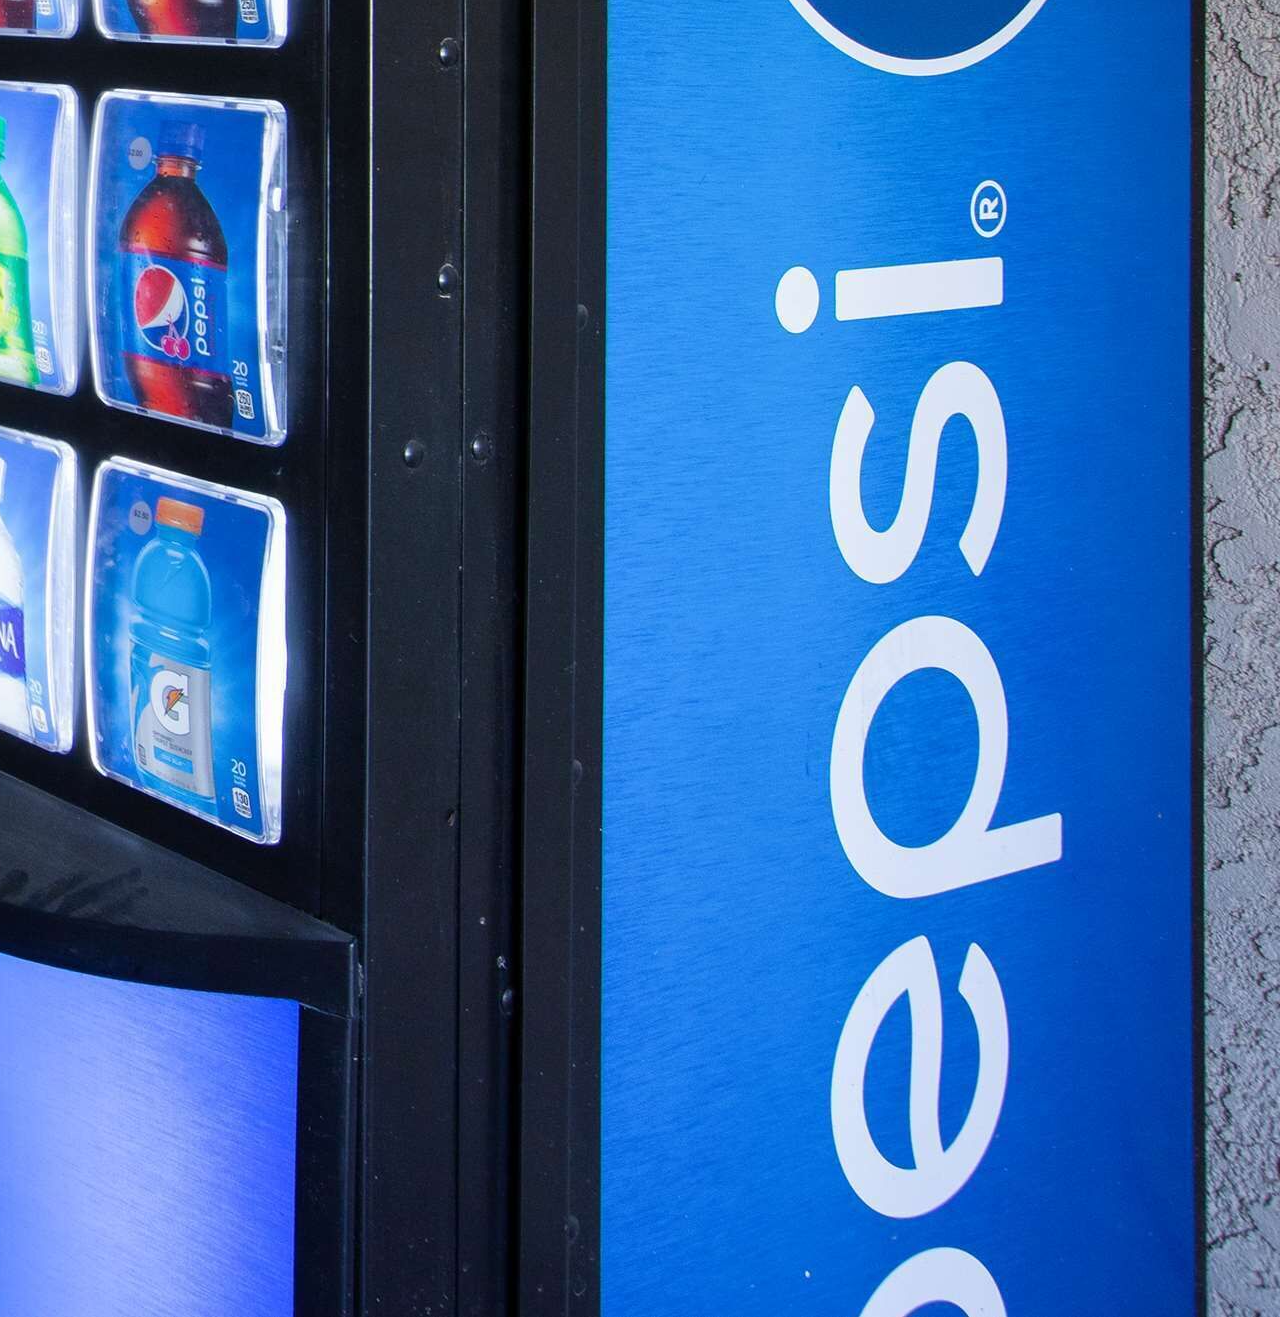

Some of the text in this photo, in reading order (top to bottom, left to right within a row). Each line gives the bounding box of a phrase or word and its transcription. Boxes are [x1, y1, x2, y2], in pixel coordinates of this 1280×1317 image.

[190, 277, 211, 356] pepsi
[232, 360, 248, 377] 20
[151, 670, 191, 736] G
[231, 758, 247, 777] 20
[776, 256, 1063, 1317] epsi
[235, 791, 249, 806] 130
